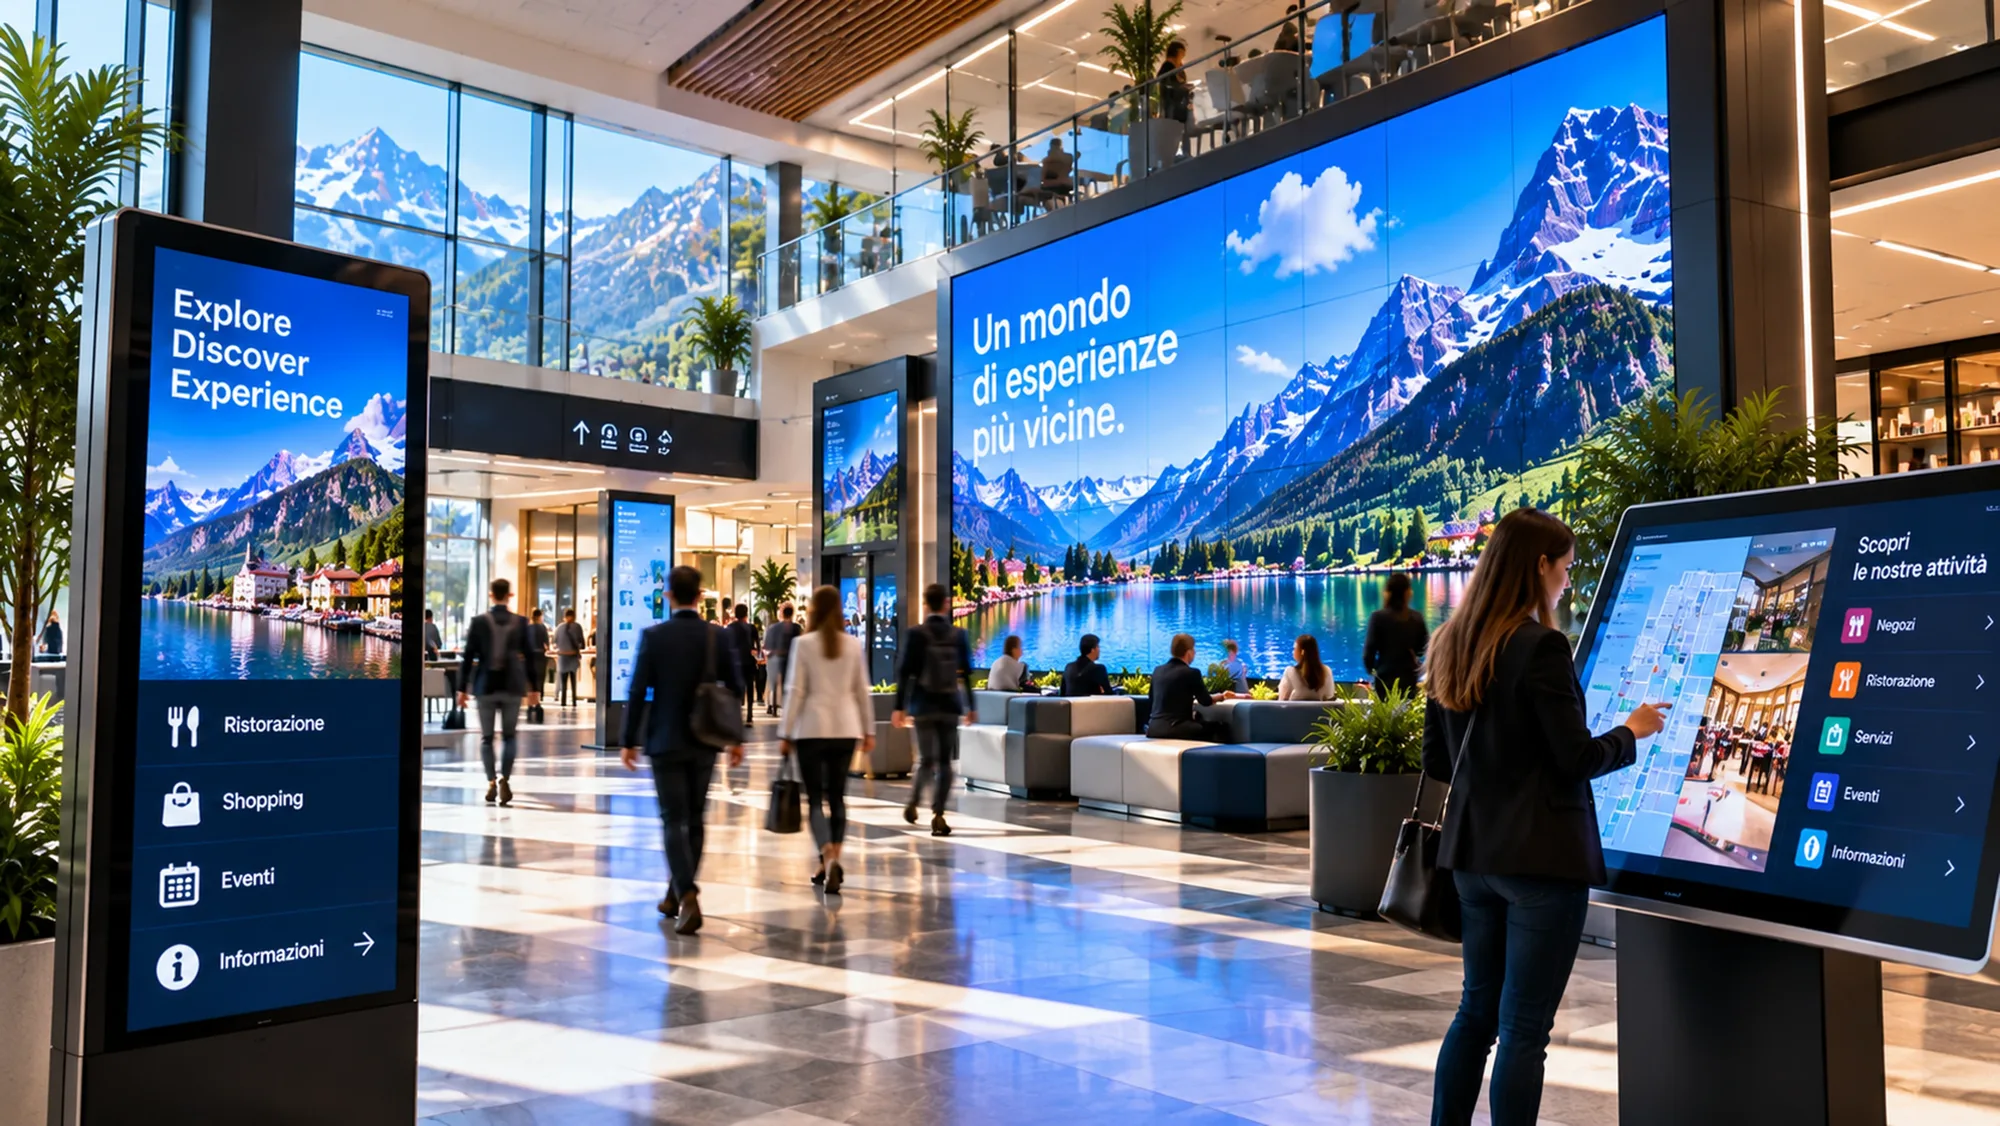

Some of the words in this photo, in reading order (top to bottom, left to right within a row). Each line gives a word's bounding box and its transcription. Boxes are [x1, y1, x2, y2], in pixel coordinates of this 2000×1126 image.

[173, 288, 292, 337] Explore
[973, 313, 1010, 355] Un
[1020, 277, 1131, 344] mondo
[172, 329, 310, 377] Discover
[972, 362, 997, 407] di
[1005, 329, 1178, 402] esperienze
[171, 368, 343, 419] Experience
[973, 411, 1015, 467] più
[1023, 398, 1125, 449] vicine.
[1858, 531, 1911, 557] Scopri
[1853, 562, 1868, 581] le
[1870, 557, 1923, 581] nostre
[1926, 553, 1988, 577] attività
[1876, 617, 1916, 634] Negozi
[1865, 673, 1936, 689] Ristorazione
[224, 715, 325, 734] Ristorazione
[1854, 729, 1893, 746] Servizi
[222, 788, 304, 813] Shopping
[1843, 786, 1880, 805] Eventi
[1831, 845, 1906, 869] Informazioni
[221, 866, 275, 890] Eventi
[219, 938, 325, 971] Informazioni
